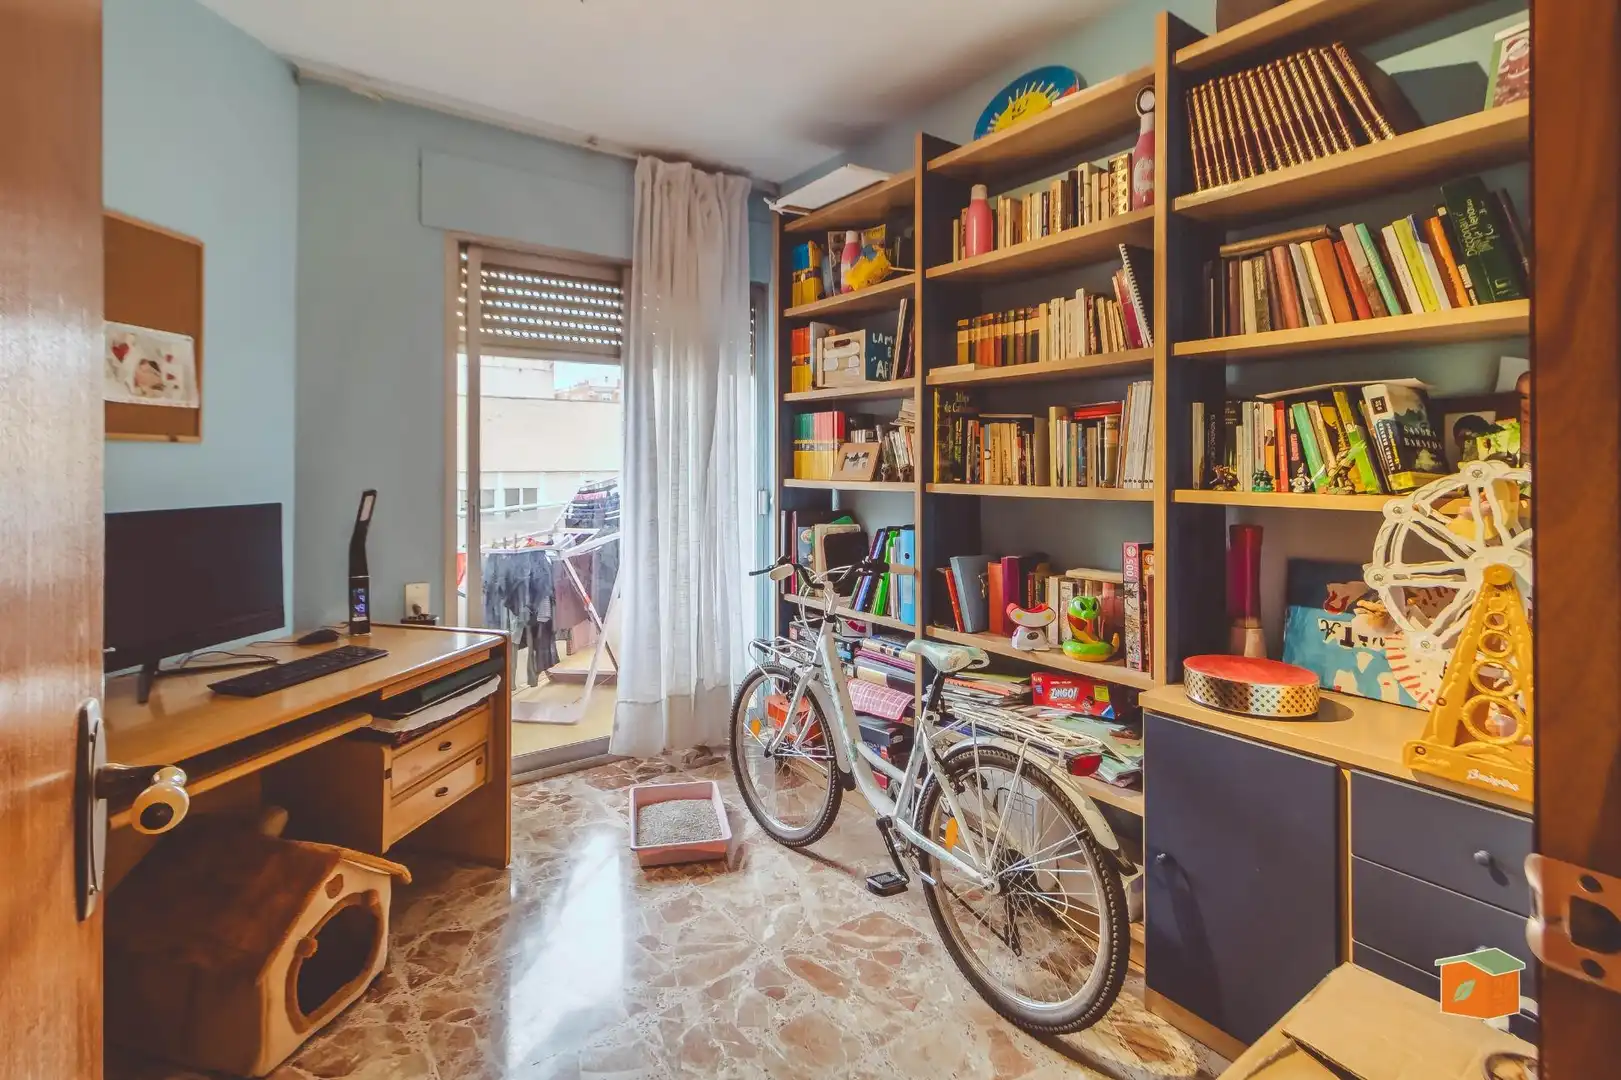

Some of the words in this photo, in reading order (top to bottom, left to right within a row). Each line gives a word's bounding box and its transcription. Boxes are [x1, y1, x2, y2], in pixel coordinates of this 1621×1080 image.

[872, 332, 896, 345] LAM
[876, 360, 892, 379] AF
[1403, 423, 1437, 438] SANDRA
[1403, 437, 1443, 450] BARNEDA
